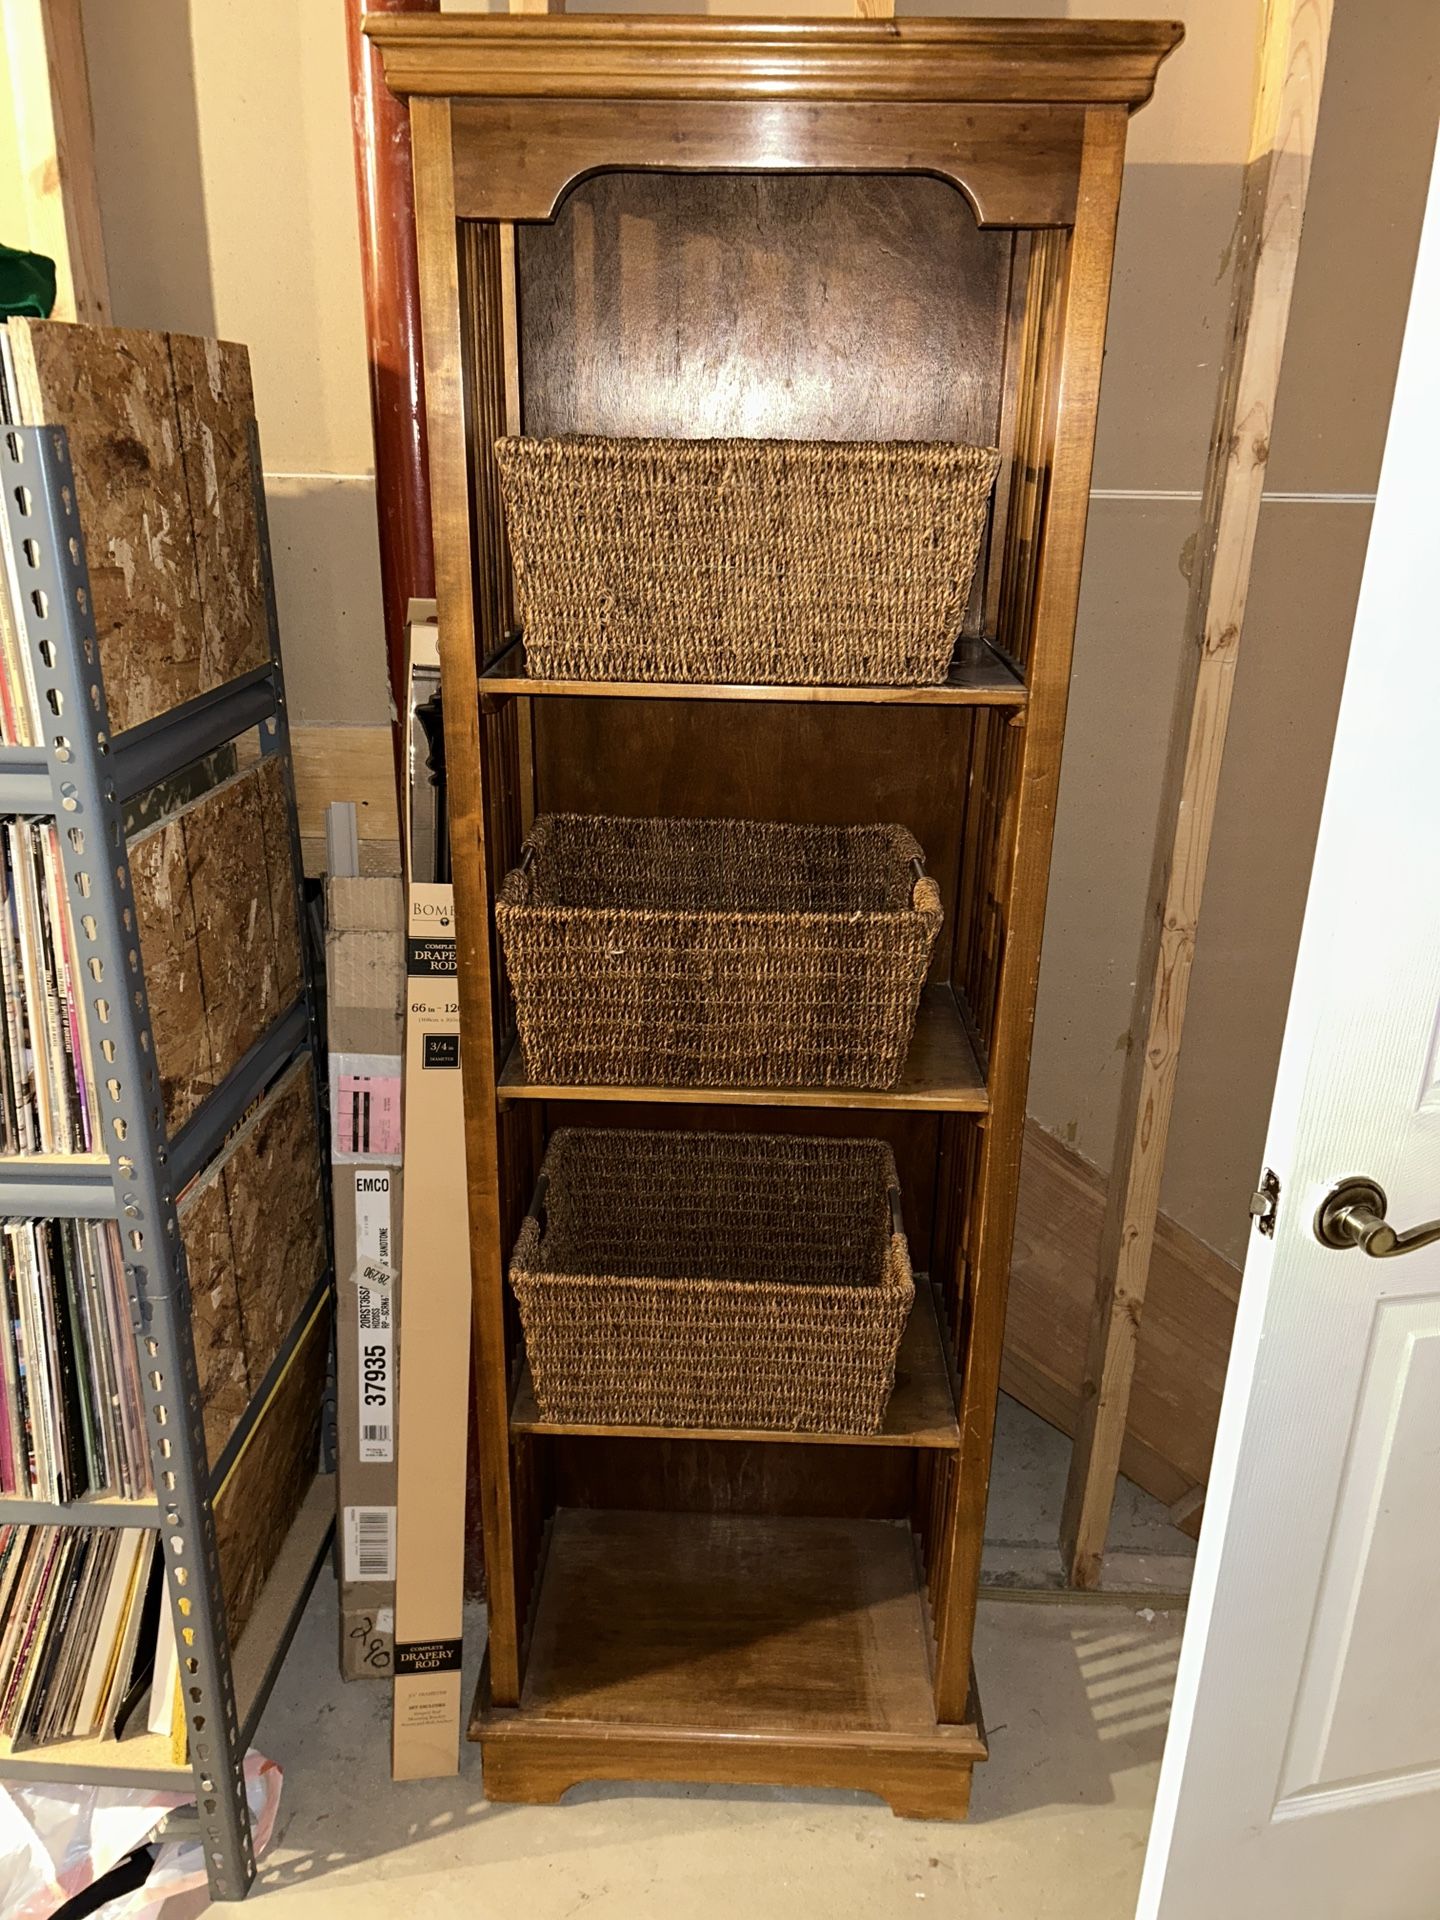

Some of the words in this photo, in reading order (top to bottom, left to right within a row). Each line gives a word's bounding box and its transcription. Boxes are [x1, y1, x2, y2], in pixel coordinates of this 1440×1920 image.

[414, 950, 457, 960] DRAPE
[430, 961, 458, 970] ROD
[411, 1003, 427, 1013] 66
[444, 1003, 461, 1013] 12
[430, 1041, 447, 1053] 3/4
[356, 1178, 389, 1192] EMCO
[379, 1227, 389, 1258] SANDTONE
[364, 1345, 387, 1406] 37935
[400, 1649, 455, 1662] DRAPERY
[415, 1659, 440, 1669] ROD
